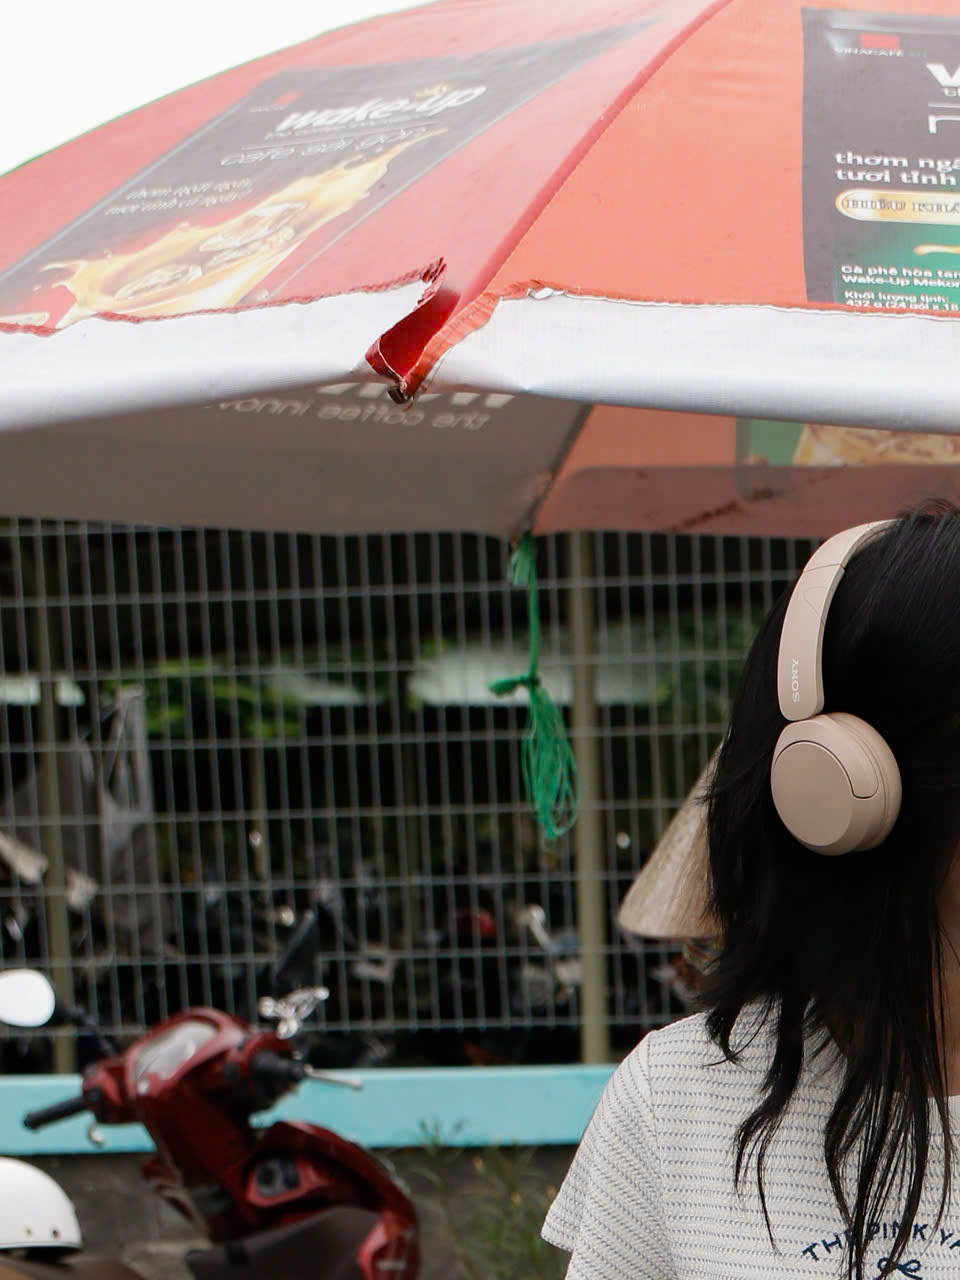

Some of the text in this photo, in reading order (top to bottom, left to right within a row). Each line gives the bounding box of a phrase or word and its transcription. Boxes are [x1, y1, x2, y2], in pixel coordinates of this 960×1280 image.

[835, 151, 908, 168] thơm
[835, 167, 890, 183] tươi
[841, 264, 863, 275] Cà
[868, 265, 899, 279] phê
[902, 266, 932, 278] hòa
[842, 274, 910, 287] Wake-Up
[844, 289, 875, 300] Khối
[879, 291, 917, 303] lượng
[791, 657, 800, 703] SONY
